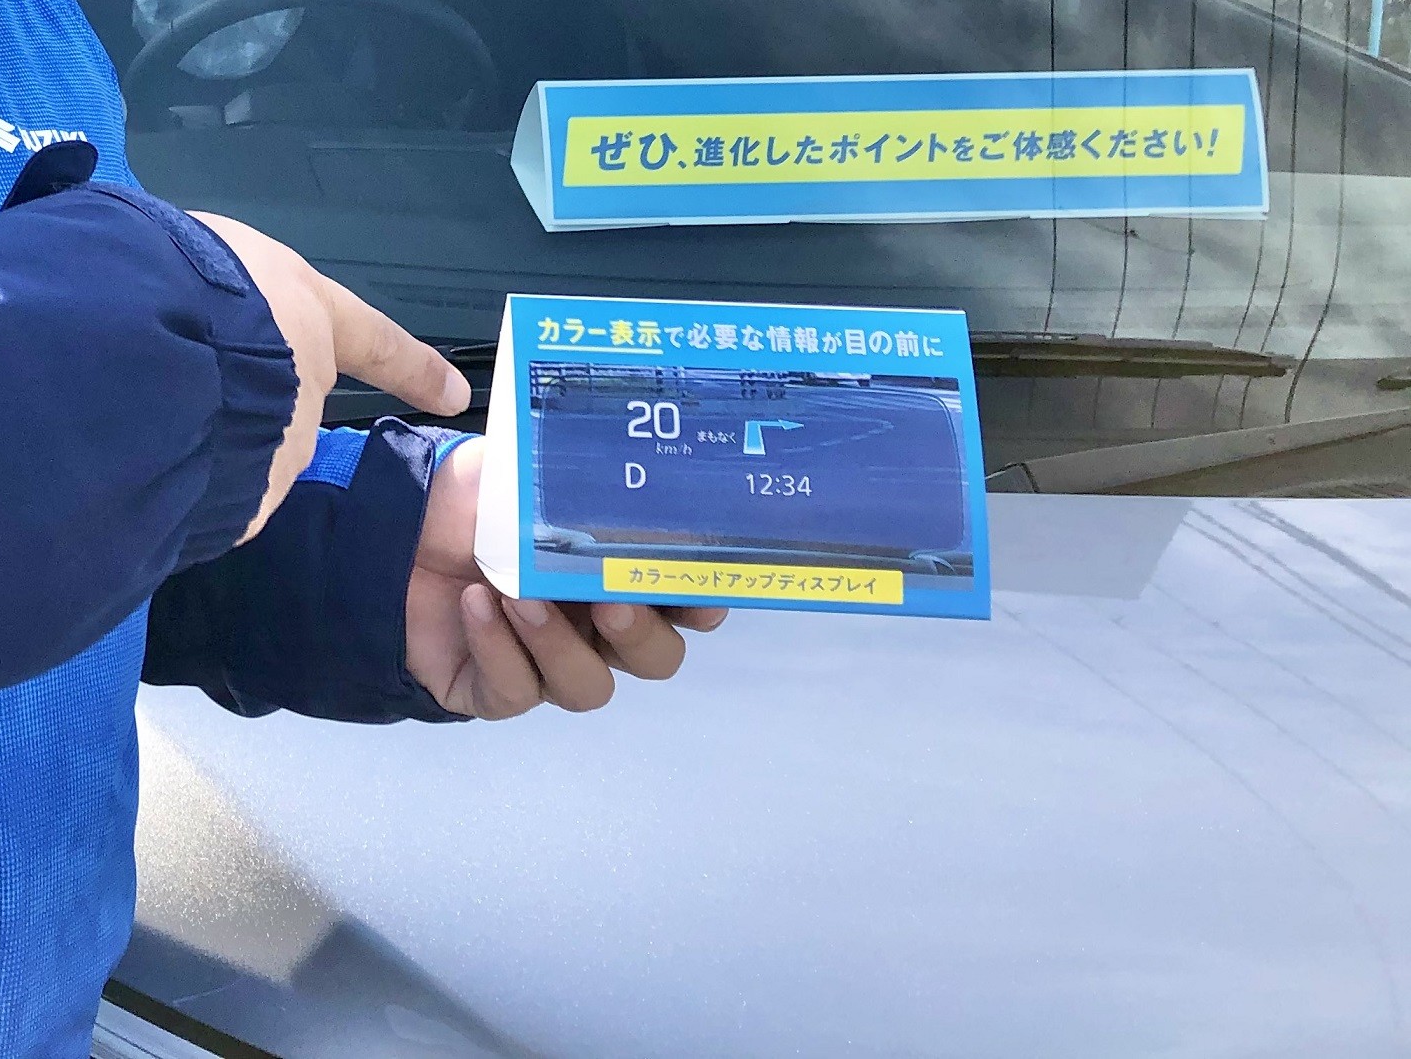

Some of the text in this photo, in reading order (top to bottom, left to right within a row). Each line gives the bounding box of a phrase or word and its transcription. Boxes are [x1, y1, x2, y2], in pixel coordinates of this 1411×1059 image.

[538, 317, 944, 358] カラー表示で必要な情報が目の前に
[626, 401, 681, 439] 20
[656, 442, 693, 456] km/h
[696, 430, 736, 444] まもなく
[624, 462, 647, 489] D
[746, 473, 813, 496] 12:34
[628, 567, 877, 594] カラーヘッドアップディスプレイ
